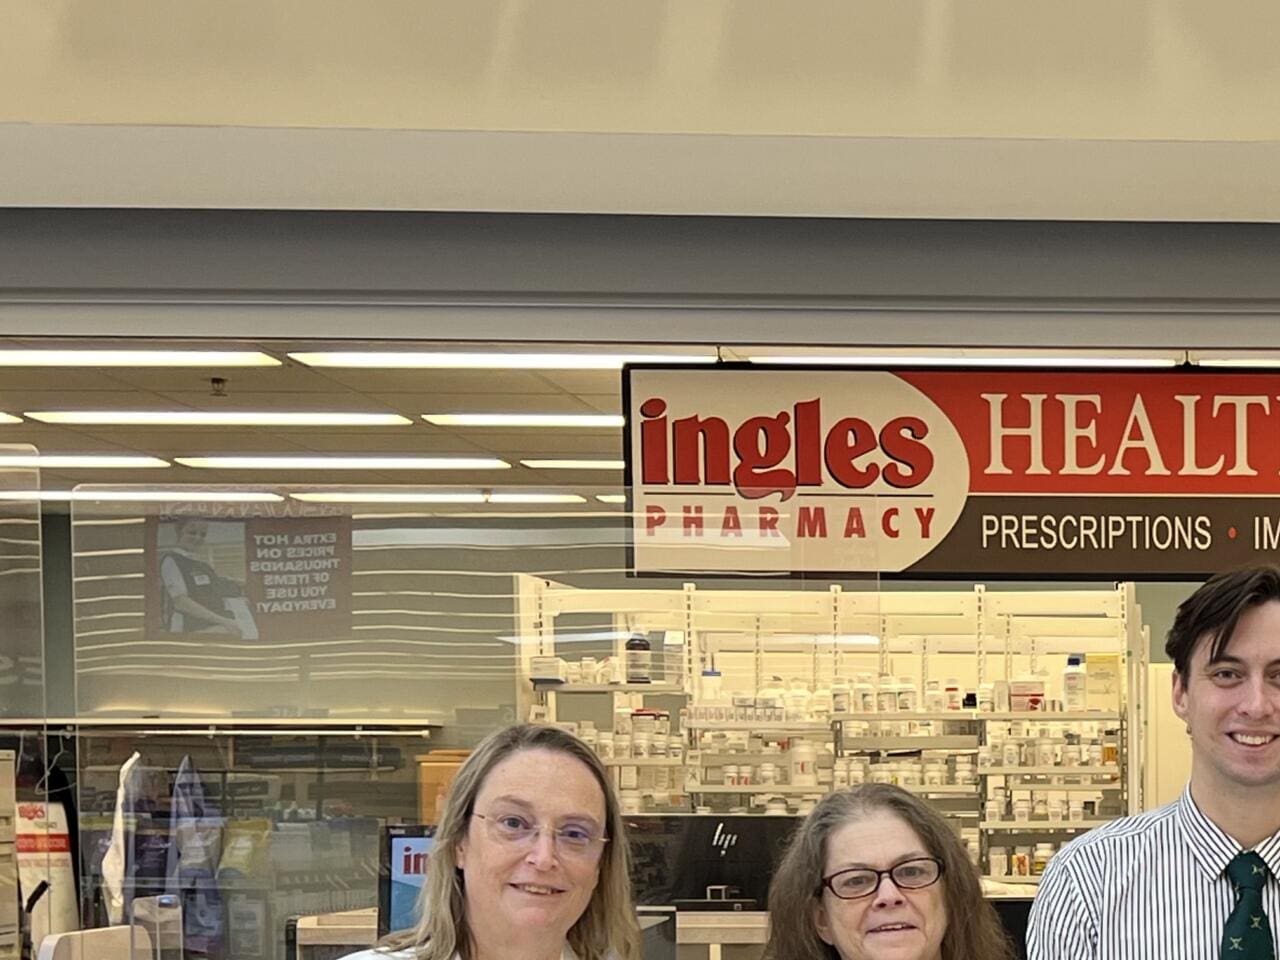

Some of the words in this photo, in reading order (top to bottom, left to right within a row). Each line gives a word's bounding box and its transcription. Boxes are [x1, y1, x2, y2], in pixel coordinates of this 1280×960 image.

[640, 398, 935, 503] ingles
[646, 505, 936, 539] PHARMACY
[981, 515, 1212, 550] PRESCRIPTIONS
